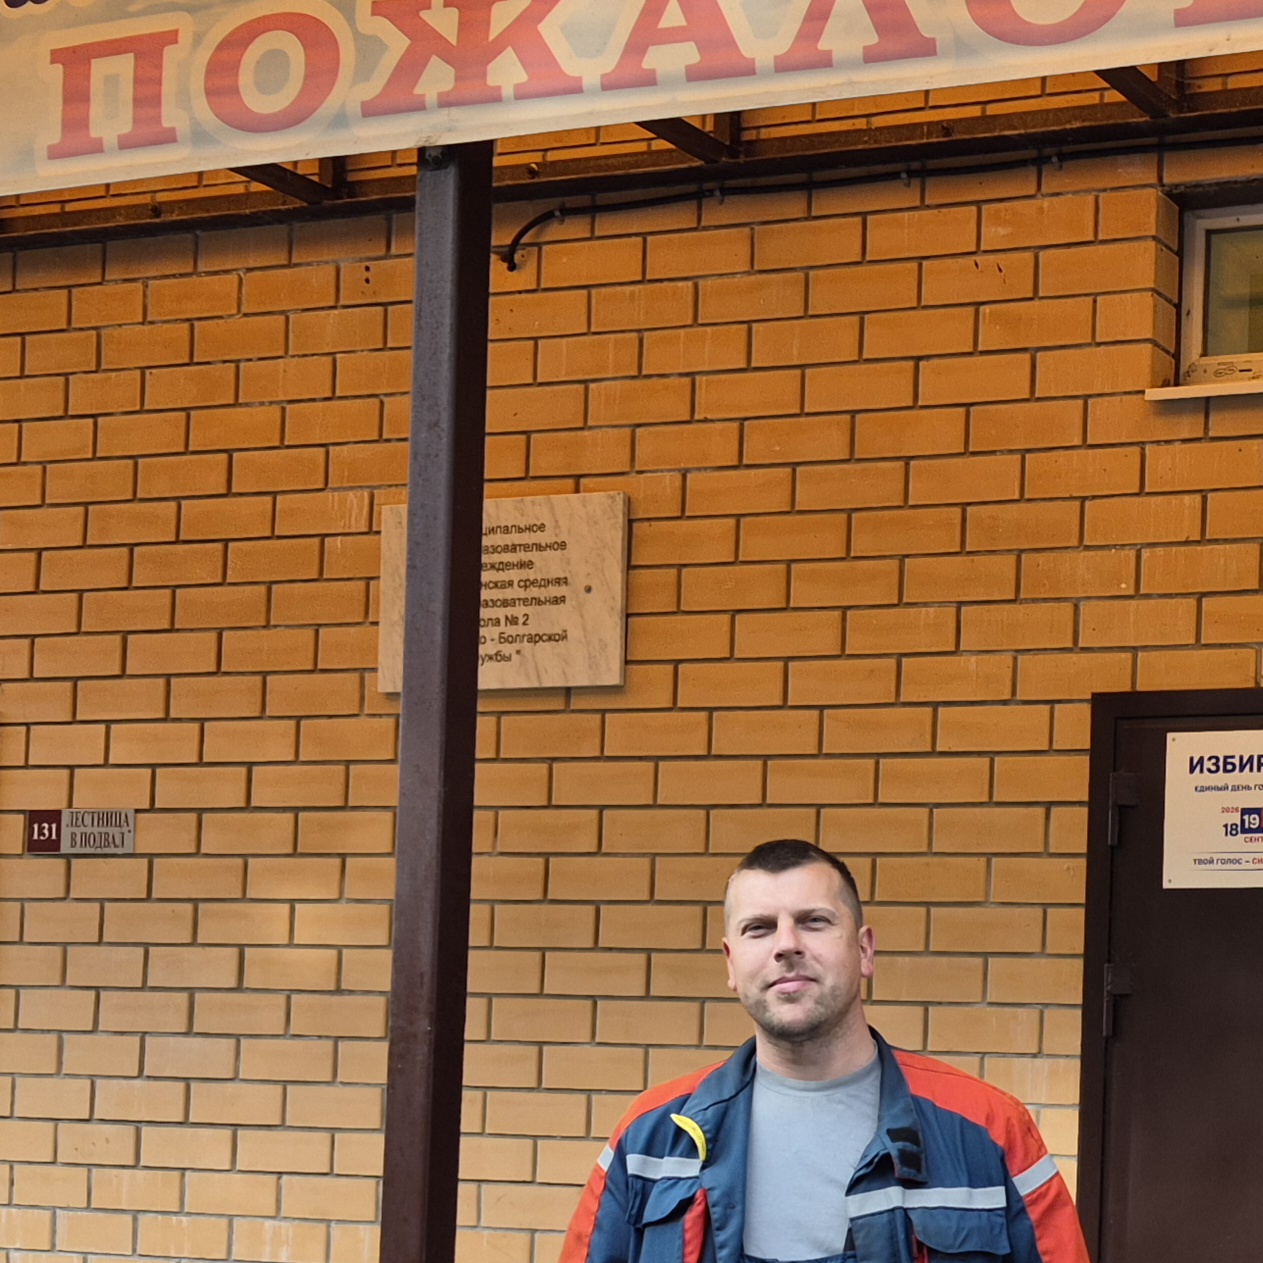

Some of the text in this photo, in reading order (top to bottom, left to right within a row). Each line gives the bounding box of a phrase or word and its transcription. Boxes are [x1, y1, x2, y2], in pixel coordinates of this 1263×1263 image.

[483, 522, 546, 536] ципальное
[483, 541, 567, 555] азовательное
[481, 560, 534, 573] еждение
[481, 595, 566, 609] азовательная
[480, 617, 501, 628] ола
[480, 650, 512, 667] ужбы
[1195, 783, 1229, 793] ЕДИНЫЙ
[1230, 784, 1252, 792] ДЕНЬ
[65, 811, 130, 828] ЛЕСТНИЦА
[1222, 823, 1239, 837] 18
[1242, 814, 1260, 829] 19
[32, 822, 58, 840] 131
[70, 831, 125, 850] В ПОДВАЛ
[1193, 856, 1215, 866] ТВОЙ
[1216, 857, 1243, 866] ГОЛОС
